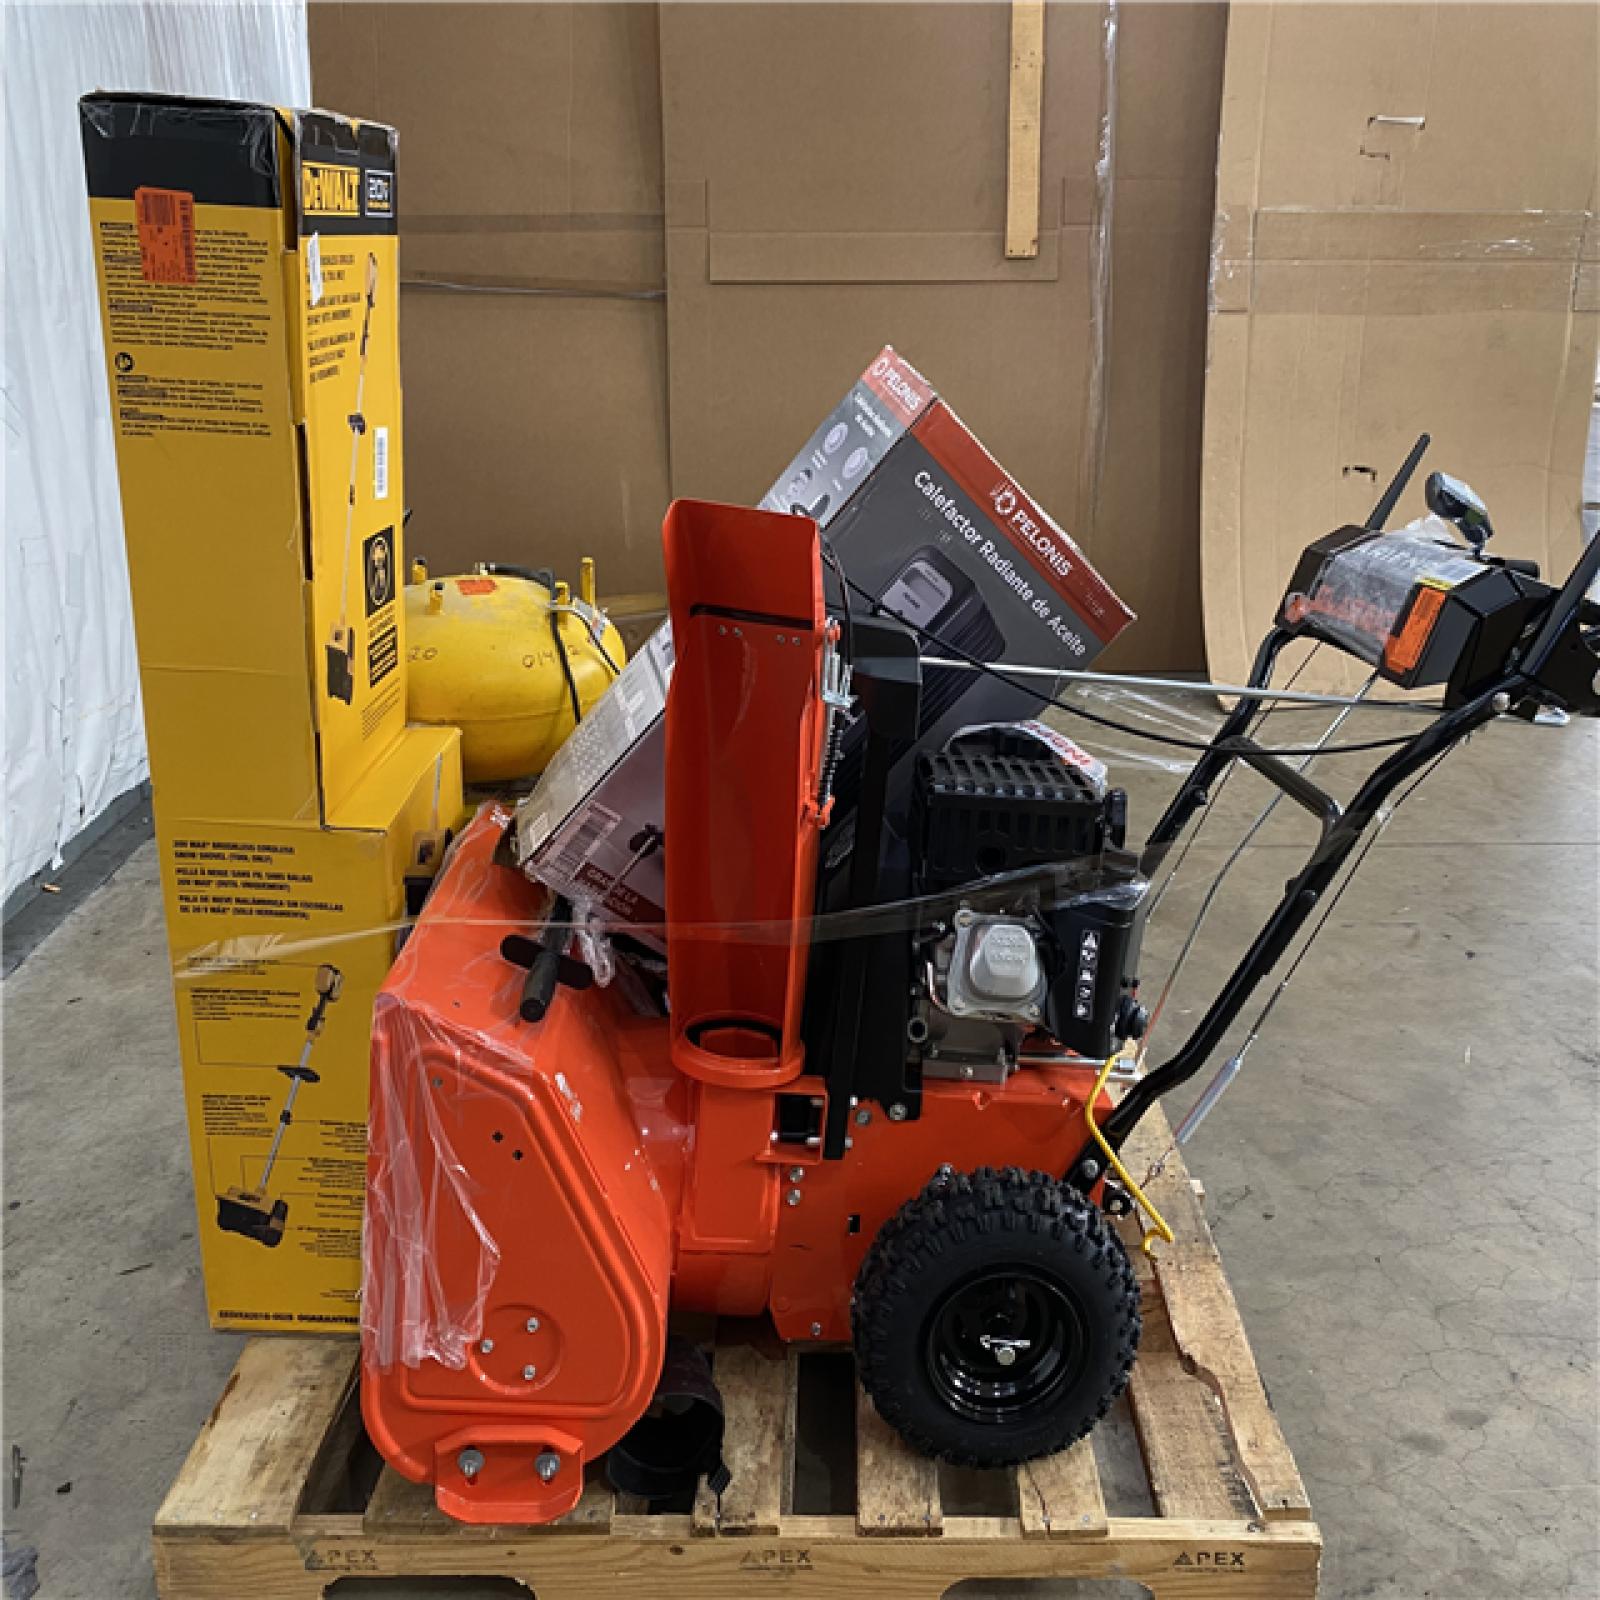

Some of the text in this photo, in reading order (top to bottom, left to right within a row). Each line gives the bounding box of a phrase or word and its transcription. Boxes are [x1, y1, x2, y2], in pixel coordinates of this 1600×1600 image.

[303, 167, 359, 211] DEWALT
[1012, 509, 1074, 577] PELONIS
[915, 470, 983, 545] Calefactor
[979, 540, 1034, 602] Radiante
[1031, 599, 1052, 619] de
[1047, 615, 1087, 657] Aceite
[304, 1550, 377, 1564] APEX
[739, 1549, 811, 1564] APEX
[1173, 1551, 1246, 1566] APEX
